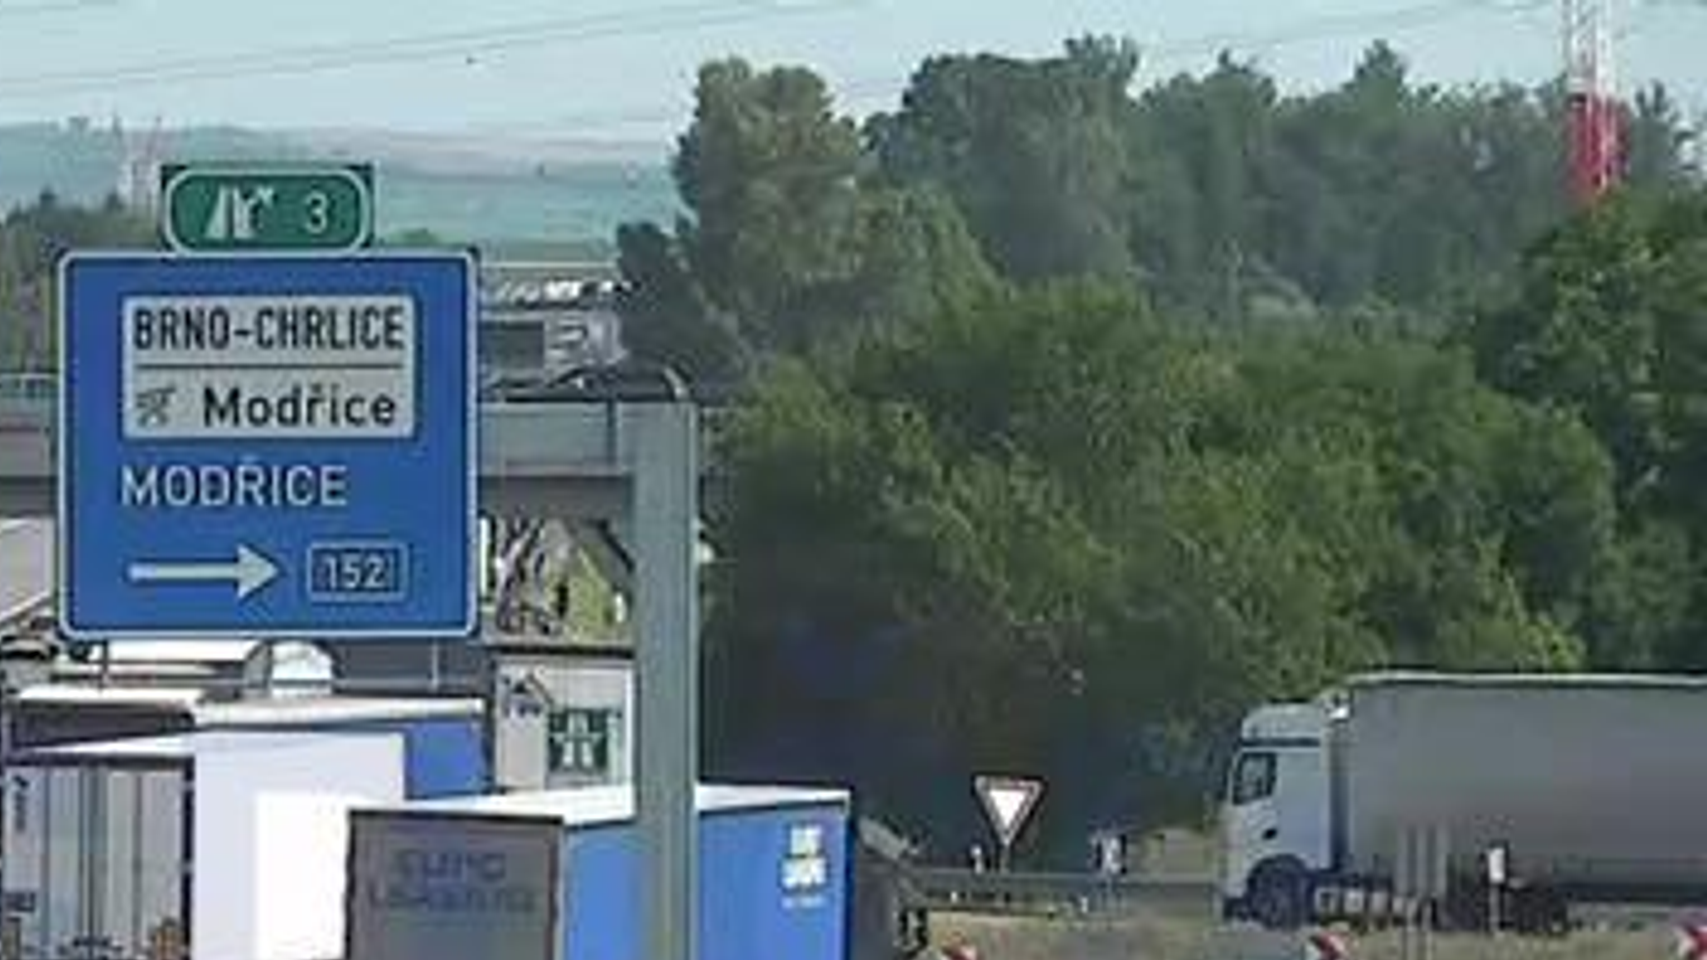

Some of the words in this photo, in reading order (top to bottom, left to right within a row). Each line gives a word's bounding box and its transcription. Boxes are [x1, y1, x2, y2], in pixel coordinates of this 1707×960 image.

[303, 196, 329, 234] 3
[133, 306, 405, 351] BRNO-CHRLICE
[202, 385, 397, 428] Modřice
[120, 459, 349, 508] MODŘICE
[319, 554, 387, 588] 152
